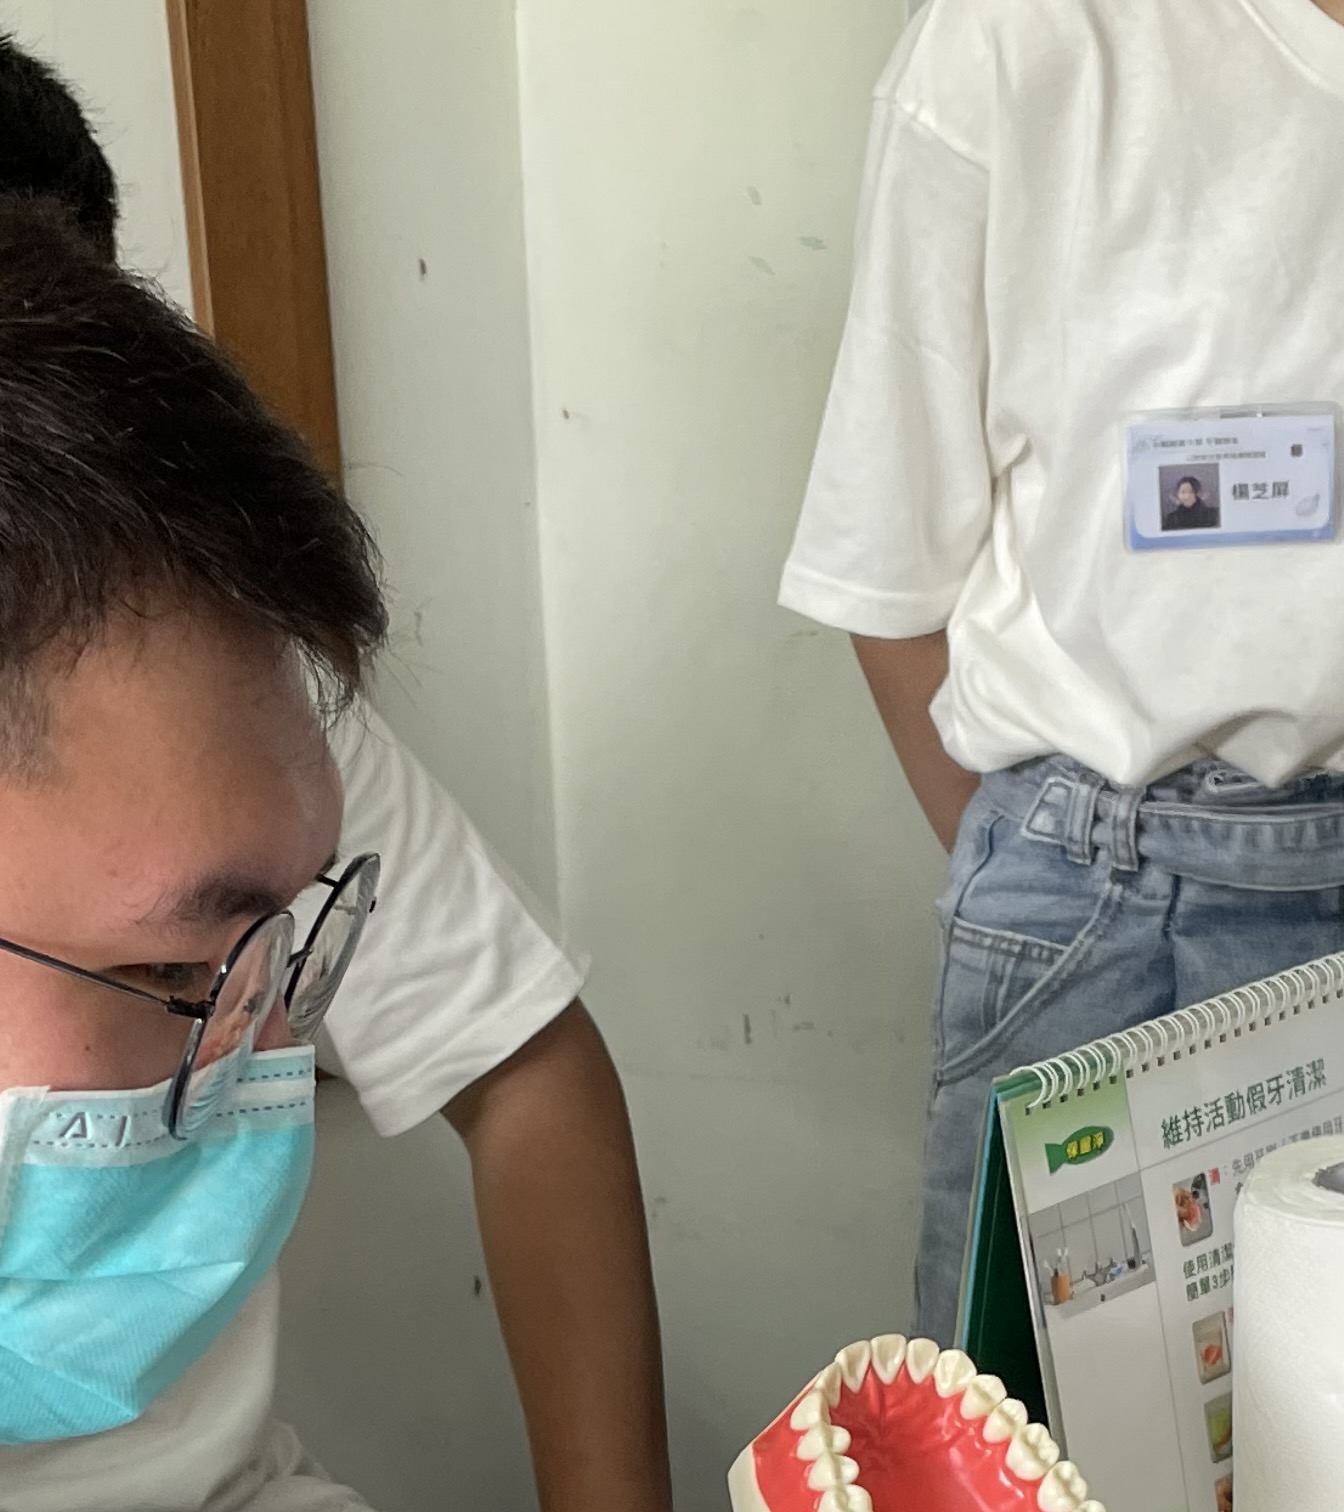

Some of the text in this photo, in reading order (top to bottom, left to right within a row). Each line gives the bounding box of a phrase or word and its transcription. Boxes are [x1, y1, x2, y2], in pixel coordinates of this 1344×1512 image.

[1160, 1057, 1329, 1151] 維持活動假牙清潔
